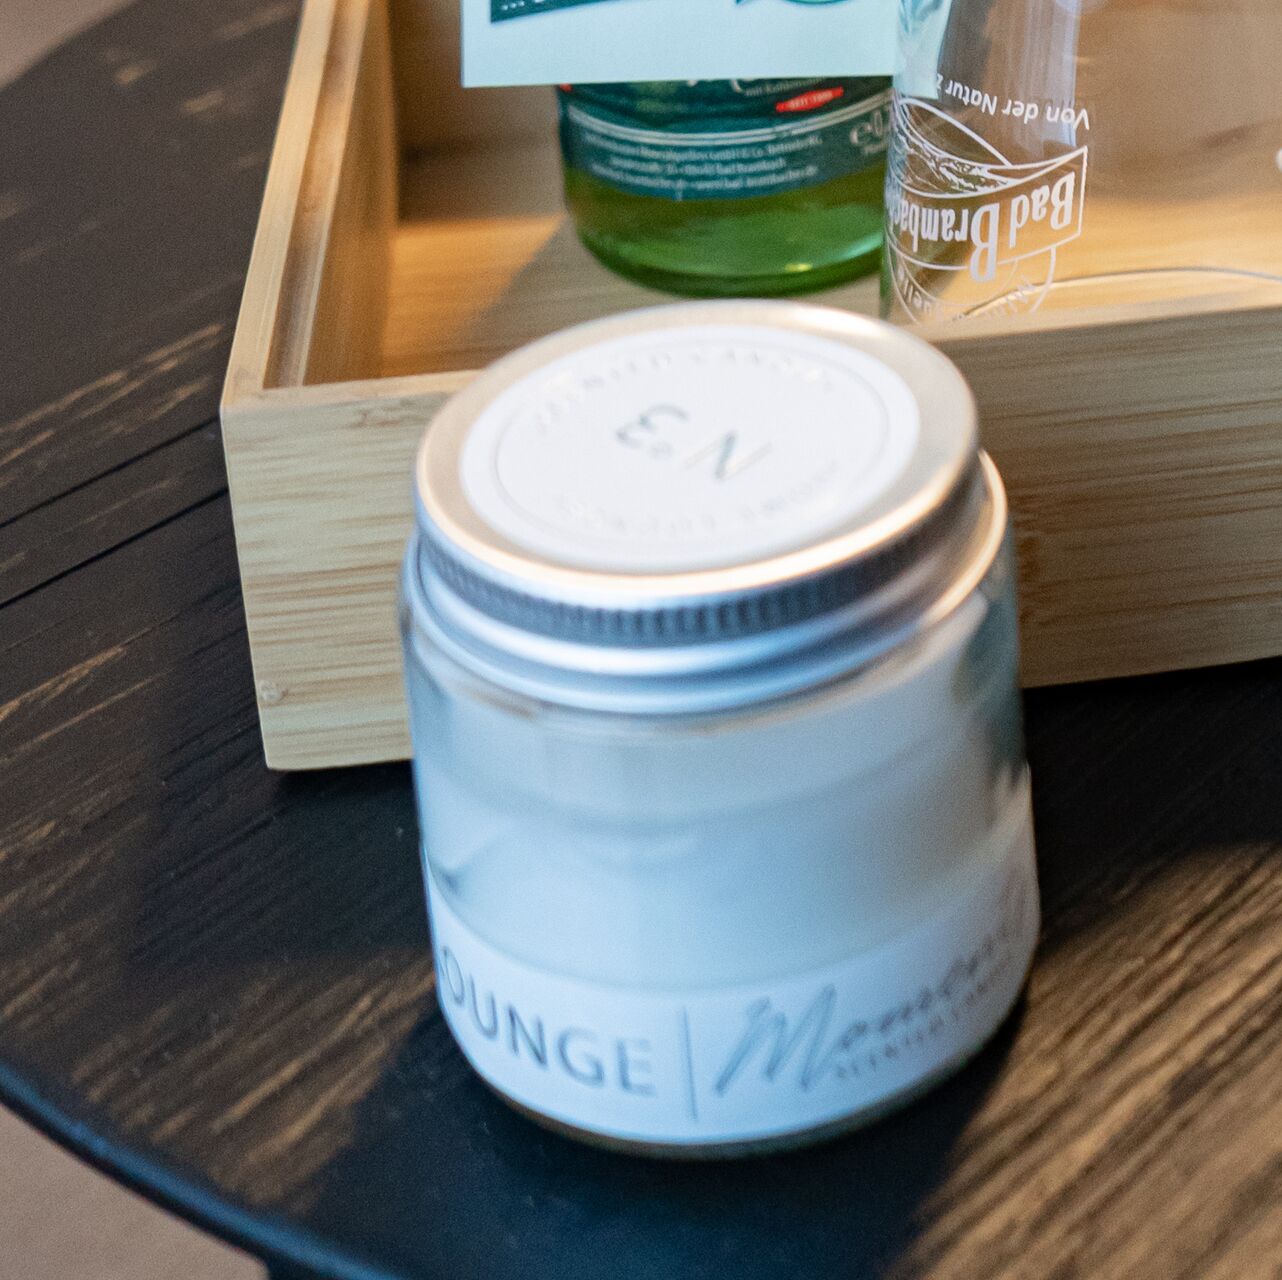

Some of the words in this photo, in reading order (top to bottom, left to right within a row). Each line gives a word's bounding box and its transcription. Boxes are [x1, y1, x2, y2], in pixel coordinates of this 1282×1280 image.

[944, 78, 999, 117] Natur
[1001, 98, 1039, 124] der
[1045, 108, 1090, 131] Von
[1009, 171, 1076, 248] Bad
[439, 944, 657, 1096] OUNGE
